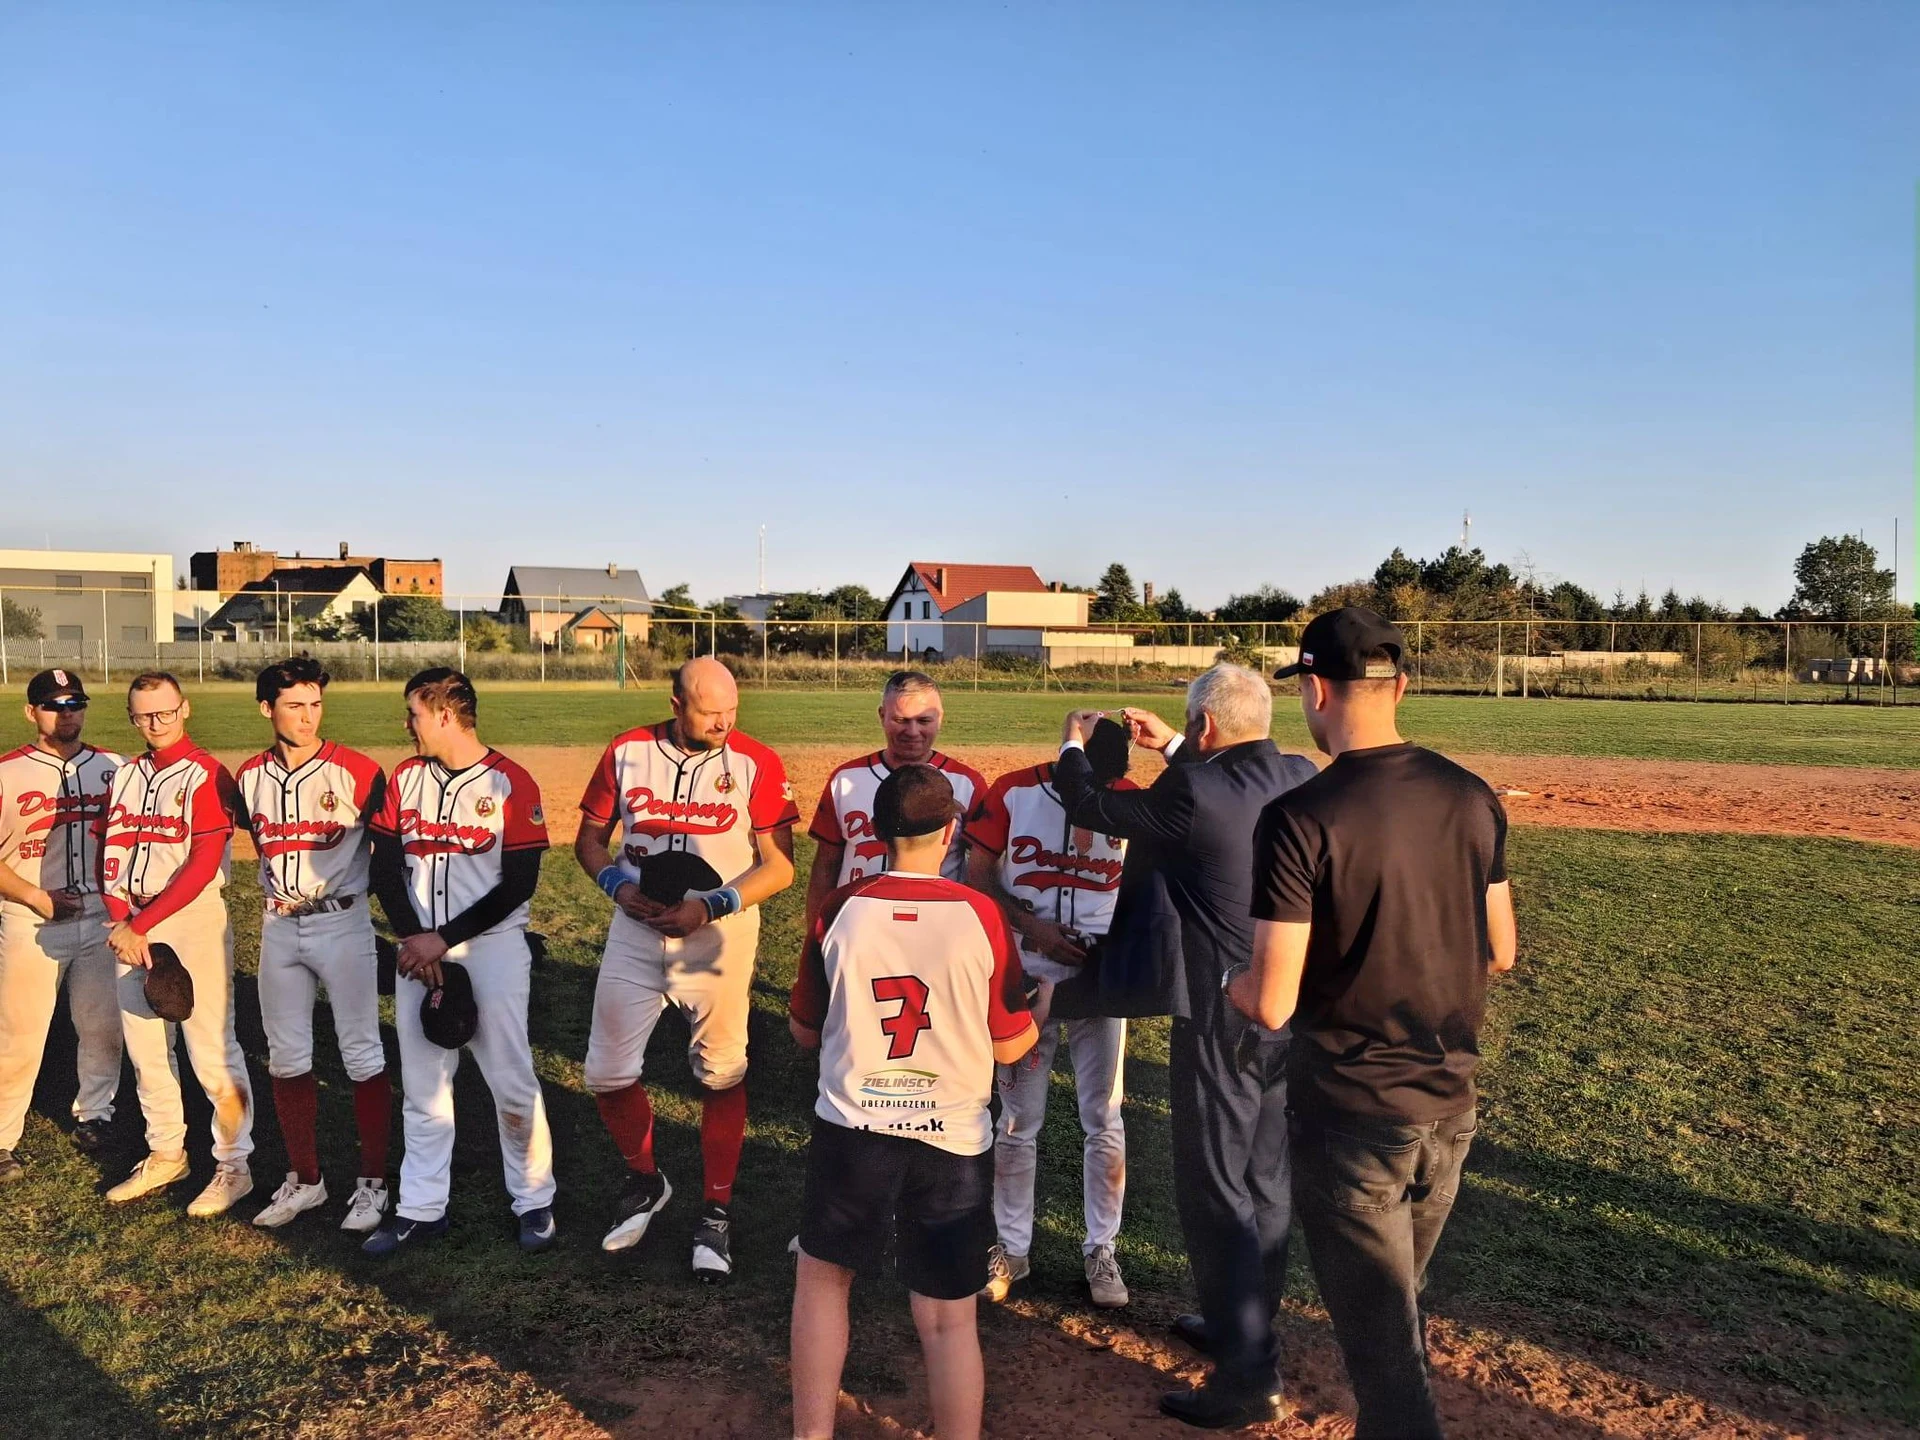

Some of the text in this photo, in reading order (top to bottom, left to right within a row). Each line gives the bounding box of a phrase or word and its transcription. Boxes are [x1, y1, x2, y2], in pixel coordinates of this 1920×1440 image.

[17, 791, 109, 816] Demon
[626, 786, 738, 827] Demony
[400, 808, 497, 849] Demony
[19, 839, 46, 859] 55
[871, 974, 931, 1060] 7
[862, 1075, 938, 1088] ZIELIŃSCY
[861, 1099, 937, 1109] UBEZPIECZENIA
